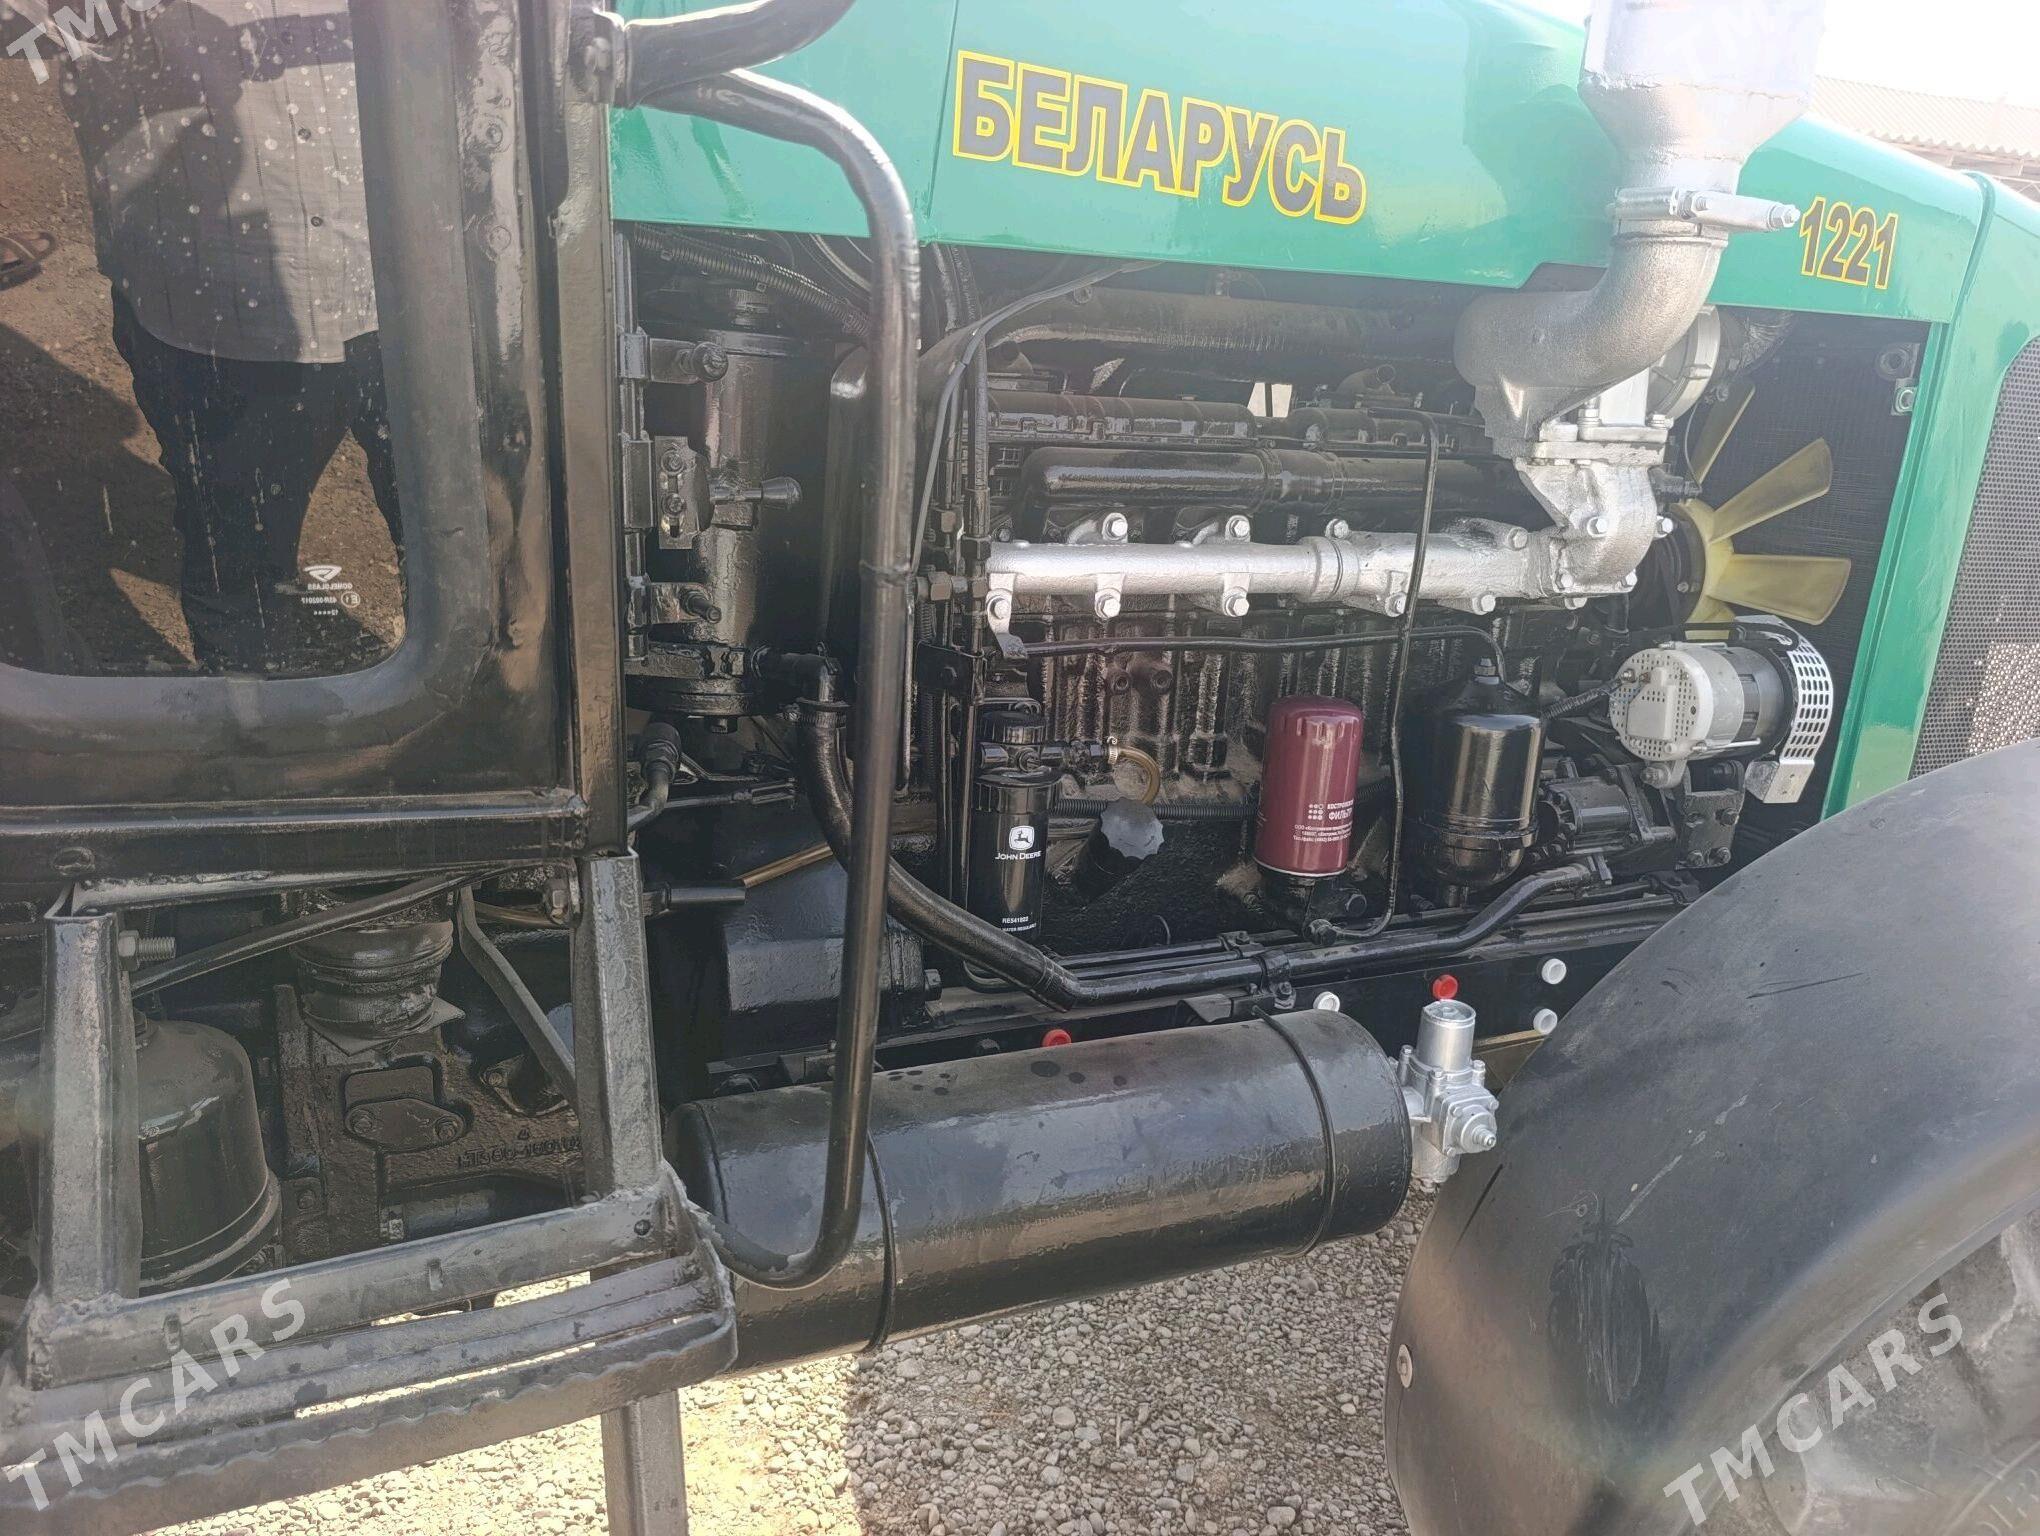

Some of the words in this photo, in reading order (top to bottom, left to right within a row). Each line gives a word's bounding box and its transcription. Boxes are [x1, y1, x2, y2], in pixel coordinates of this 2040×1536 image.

[953, 50, 1366, 224] БЕЛАРУСЬ
[1800, 196, 1899, 289] 1221
[995, 852, 1018, 860] JOHN
[1019, 850, 1042, 860] DEERE
